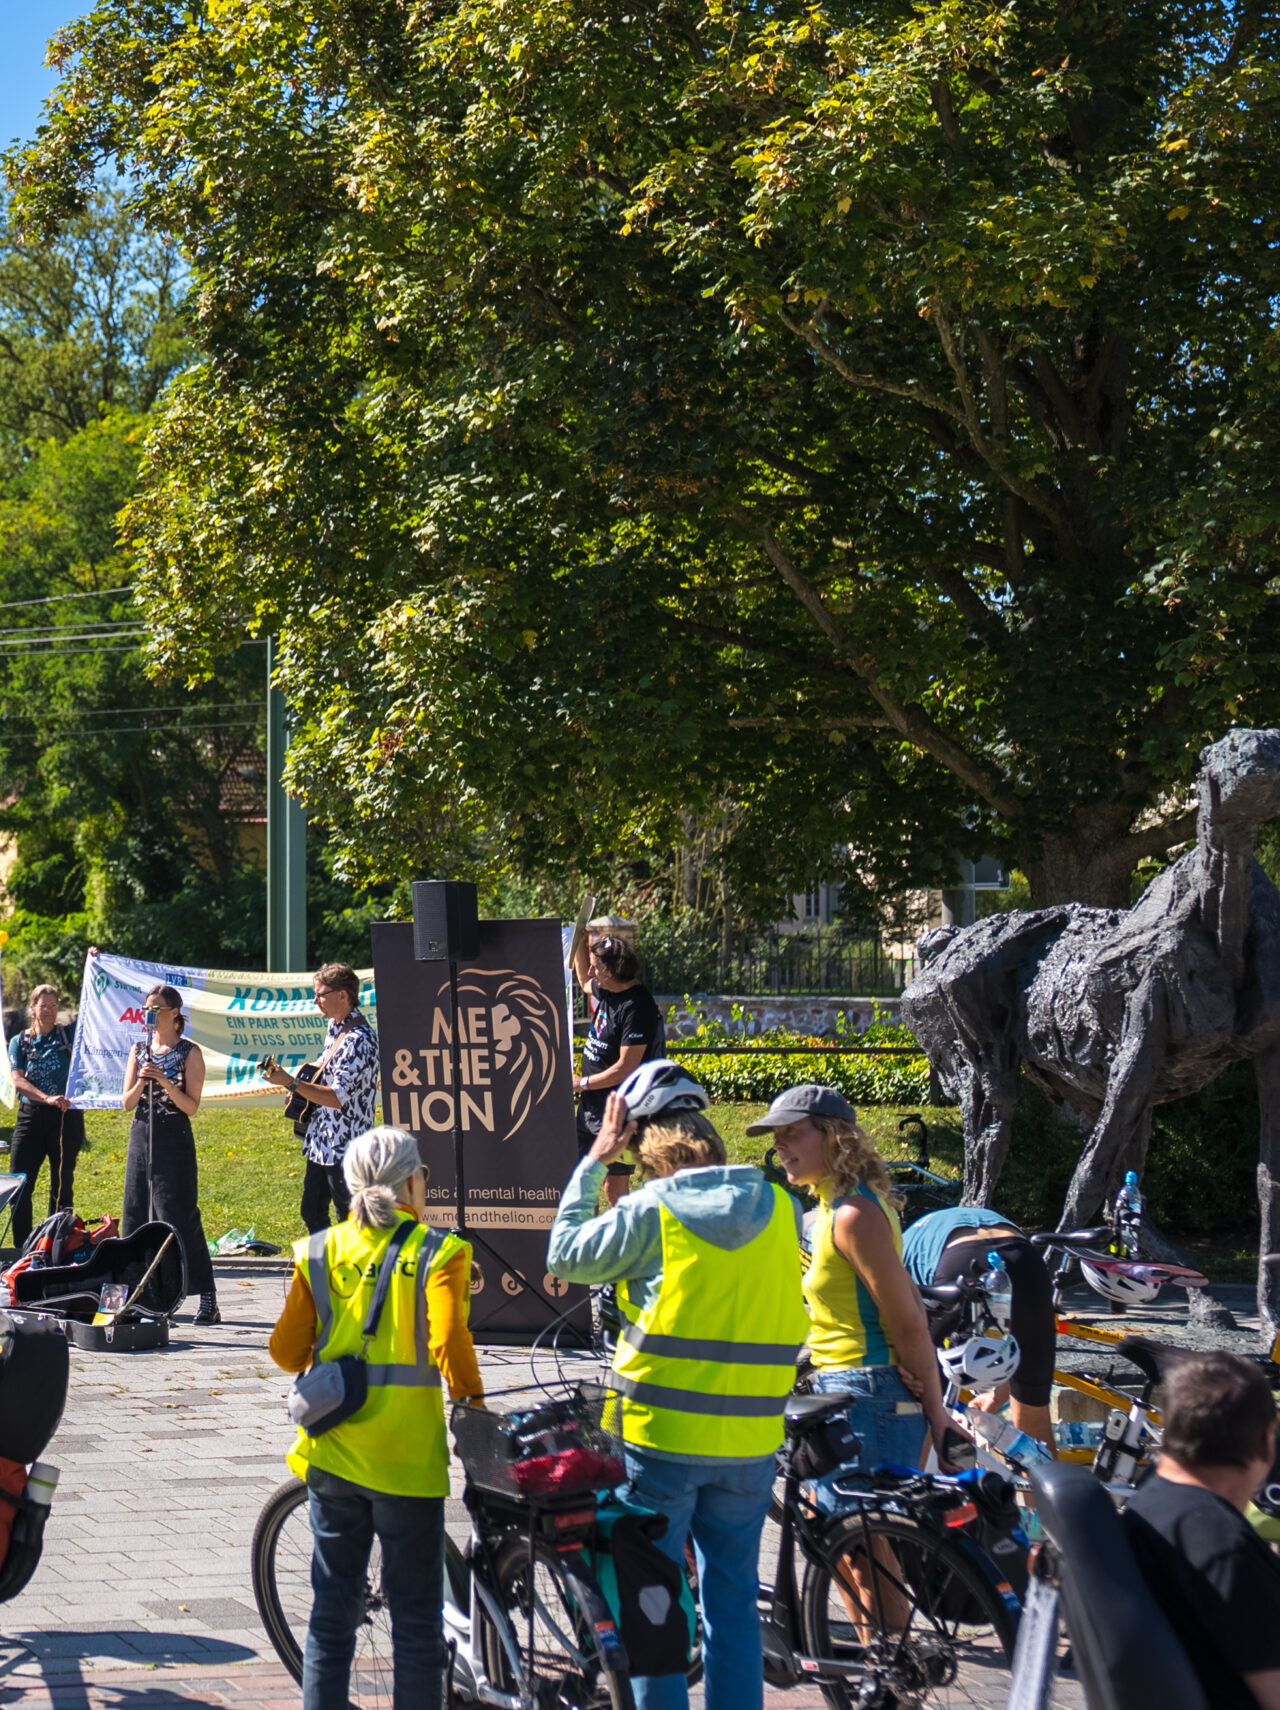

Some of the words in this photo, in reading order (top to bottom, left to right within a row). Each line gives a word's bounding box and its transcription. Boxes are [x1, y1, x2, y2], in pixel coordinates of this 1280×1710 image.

[227, 1016, 246, 1029] EIN
[248, 1017, 279, 1029] PAAR
[282, 1016, 328, 1029] STUNDE
[431, 1006, 488, 1045] ME
[232, 1033, 249, 1046] ZU
[251, 1033, 285, 1046] FUSS
[288, 1033, 323, 1046] ODER
[390, 1090, 495, 1132] LION
[424, 1185, 450, 1200] usic
[468, 1186, 515, 1200] mental
[518, 1186, 561, 1201] health
